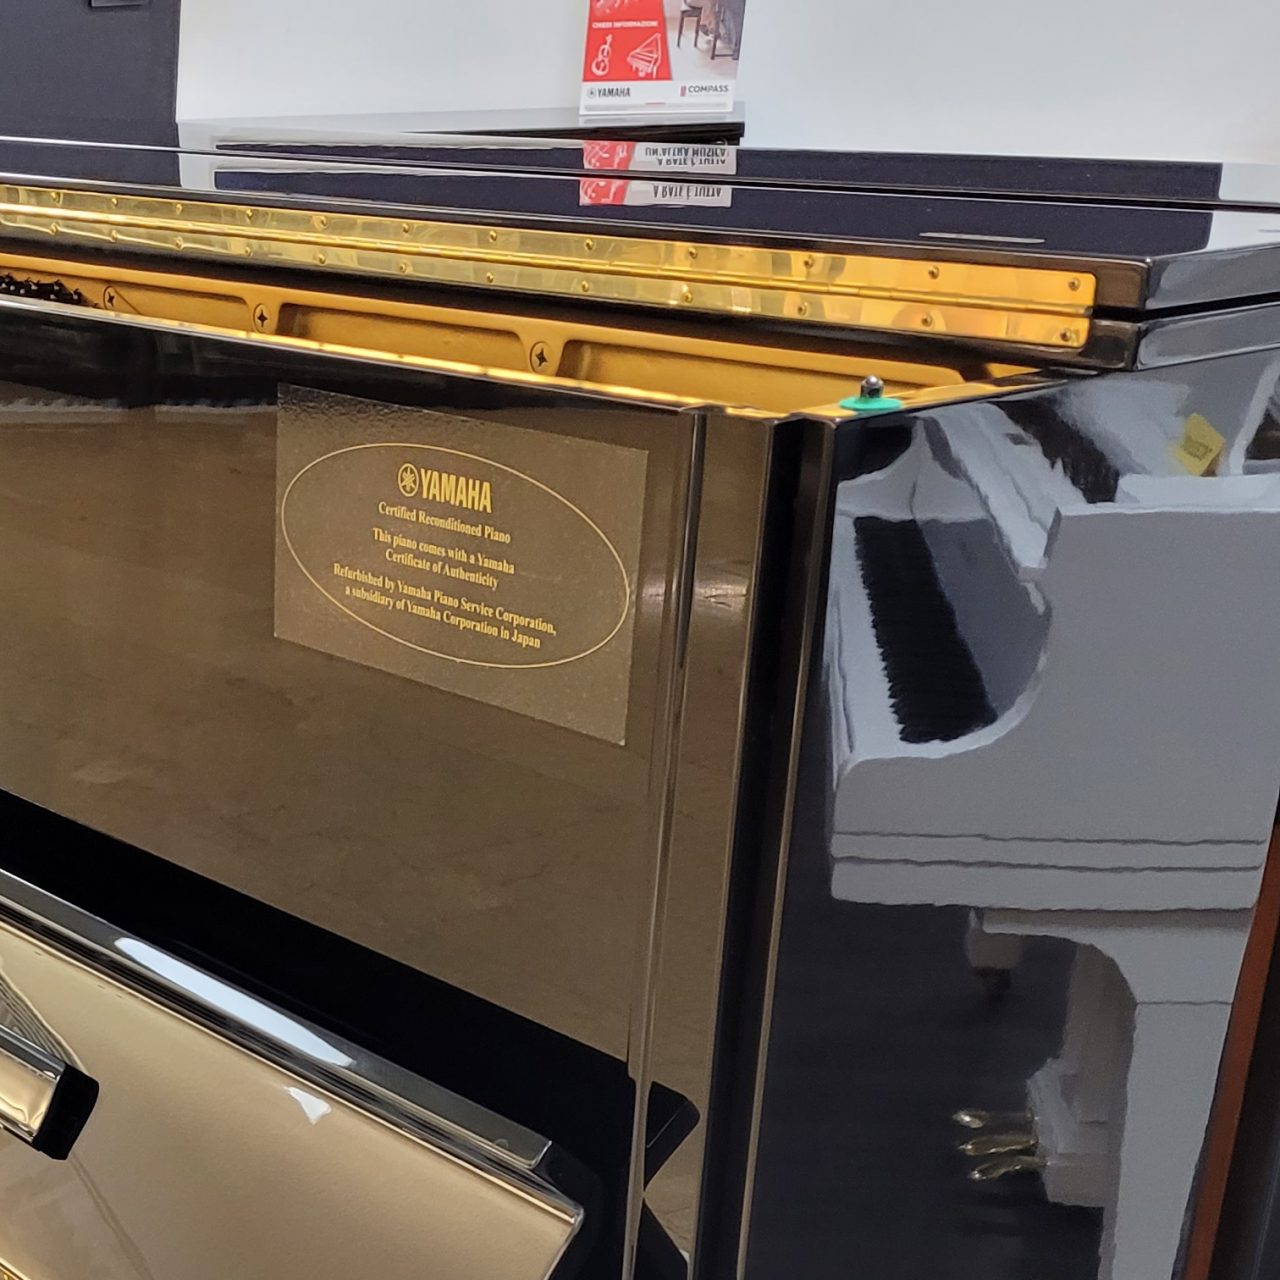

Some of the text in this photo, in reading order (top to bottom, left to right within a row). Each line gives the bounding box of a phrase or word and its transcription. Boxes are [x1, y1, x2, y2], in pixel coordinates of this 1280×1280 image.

[597, 87, 631, 98] YAMAHA
[687, 84, 729, 94] COMPASS
[420, 467, 493, 514] YAMAHA
[378, 501, 511, 545] Certified Reconditioned Piano
[372, 527, 515, 575] This piano comes with a Yamaha
[385, 548, 499, 591] Certificate of Authenticity
[333, 562, 557, 637] Refurbished by Yamaha Piano Service Corporation,
[345, 585, 541, 649] a subsidiary of Yamaha Corporation in Japan
